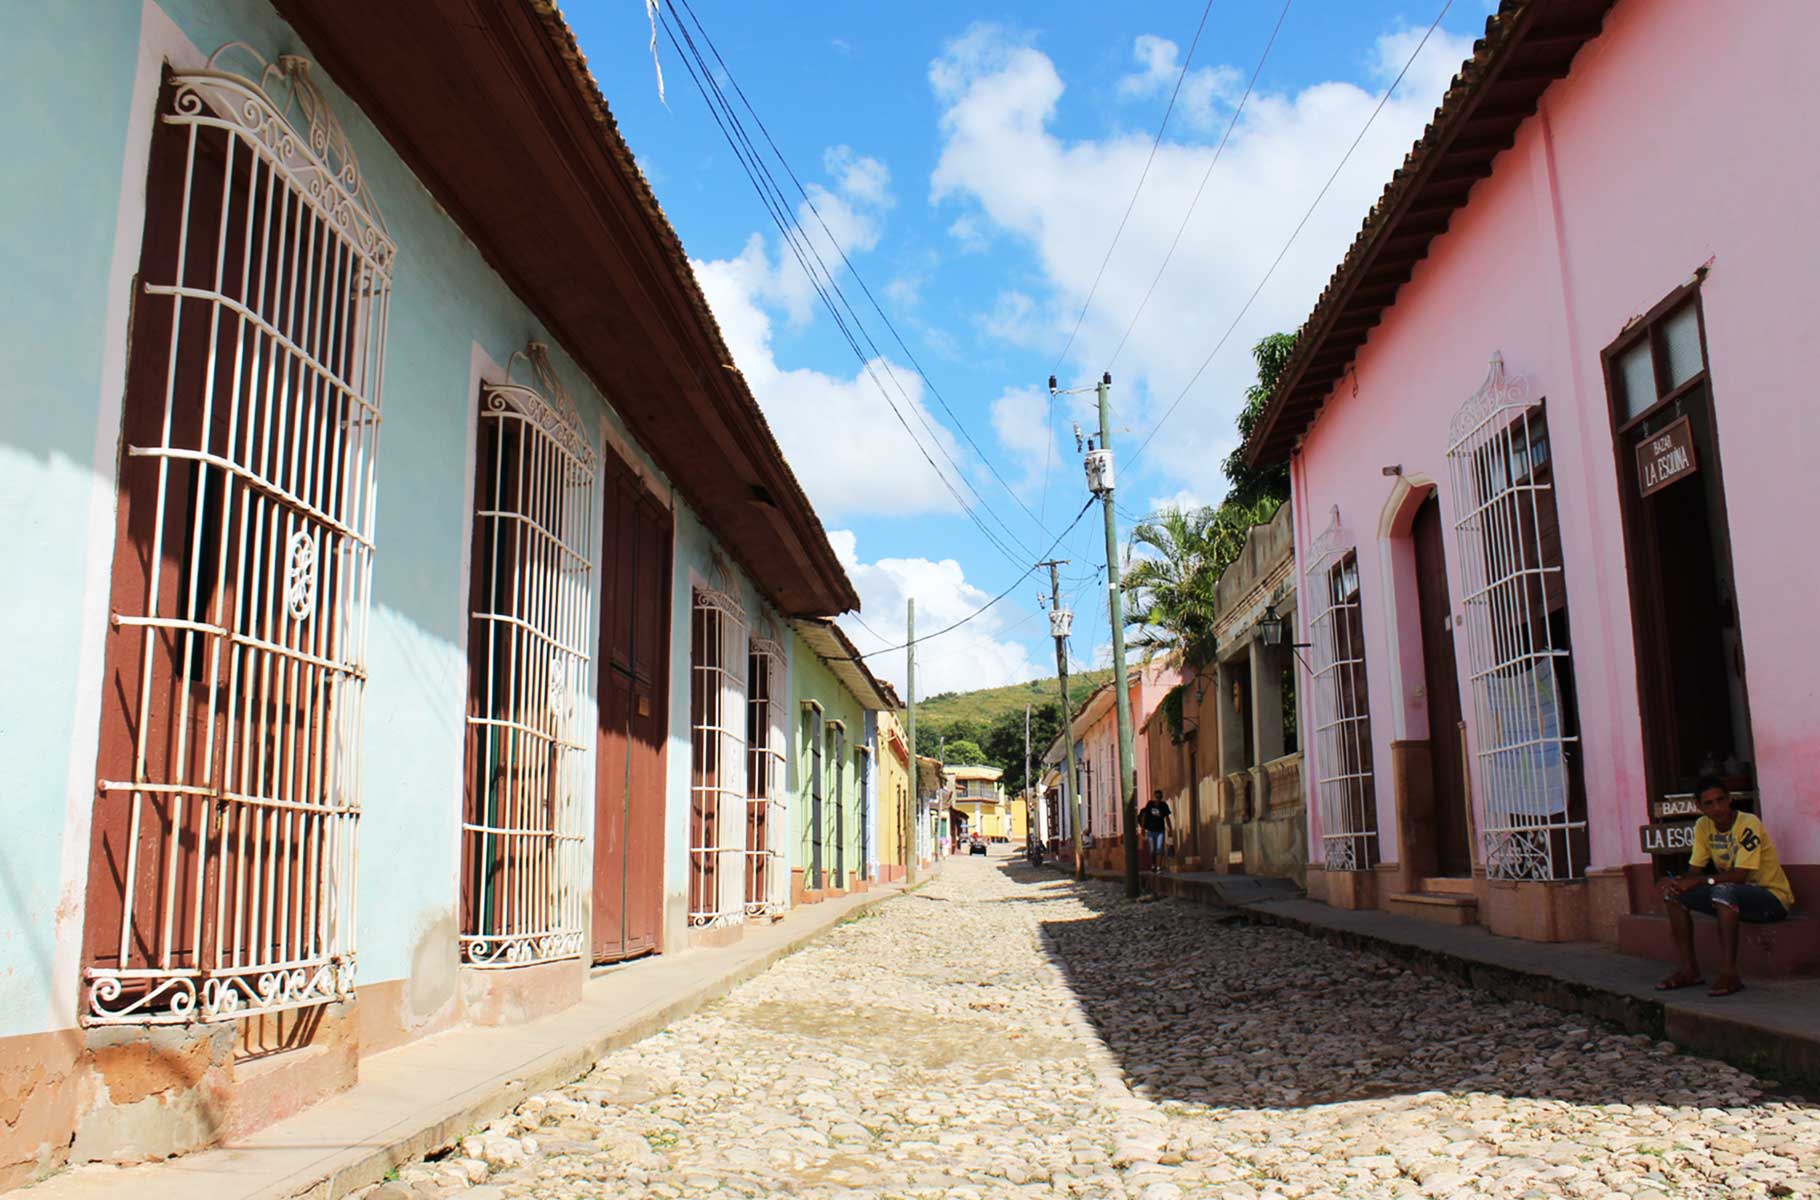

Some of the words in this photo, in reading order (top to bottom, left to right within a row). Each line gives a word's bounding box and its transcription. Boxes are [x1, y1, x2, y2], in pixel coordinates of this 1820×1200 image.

[1653, 434, 1673, 455] BAZAR
[1644, 463, 1658, 487] LA
[1645, 829, 1665, 849] LA
